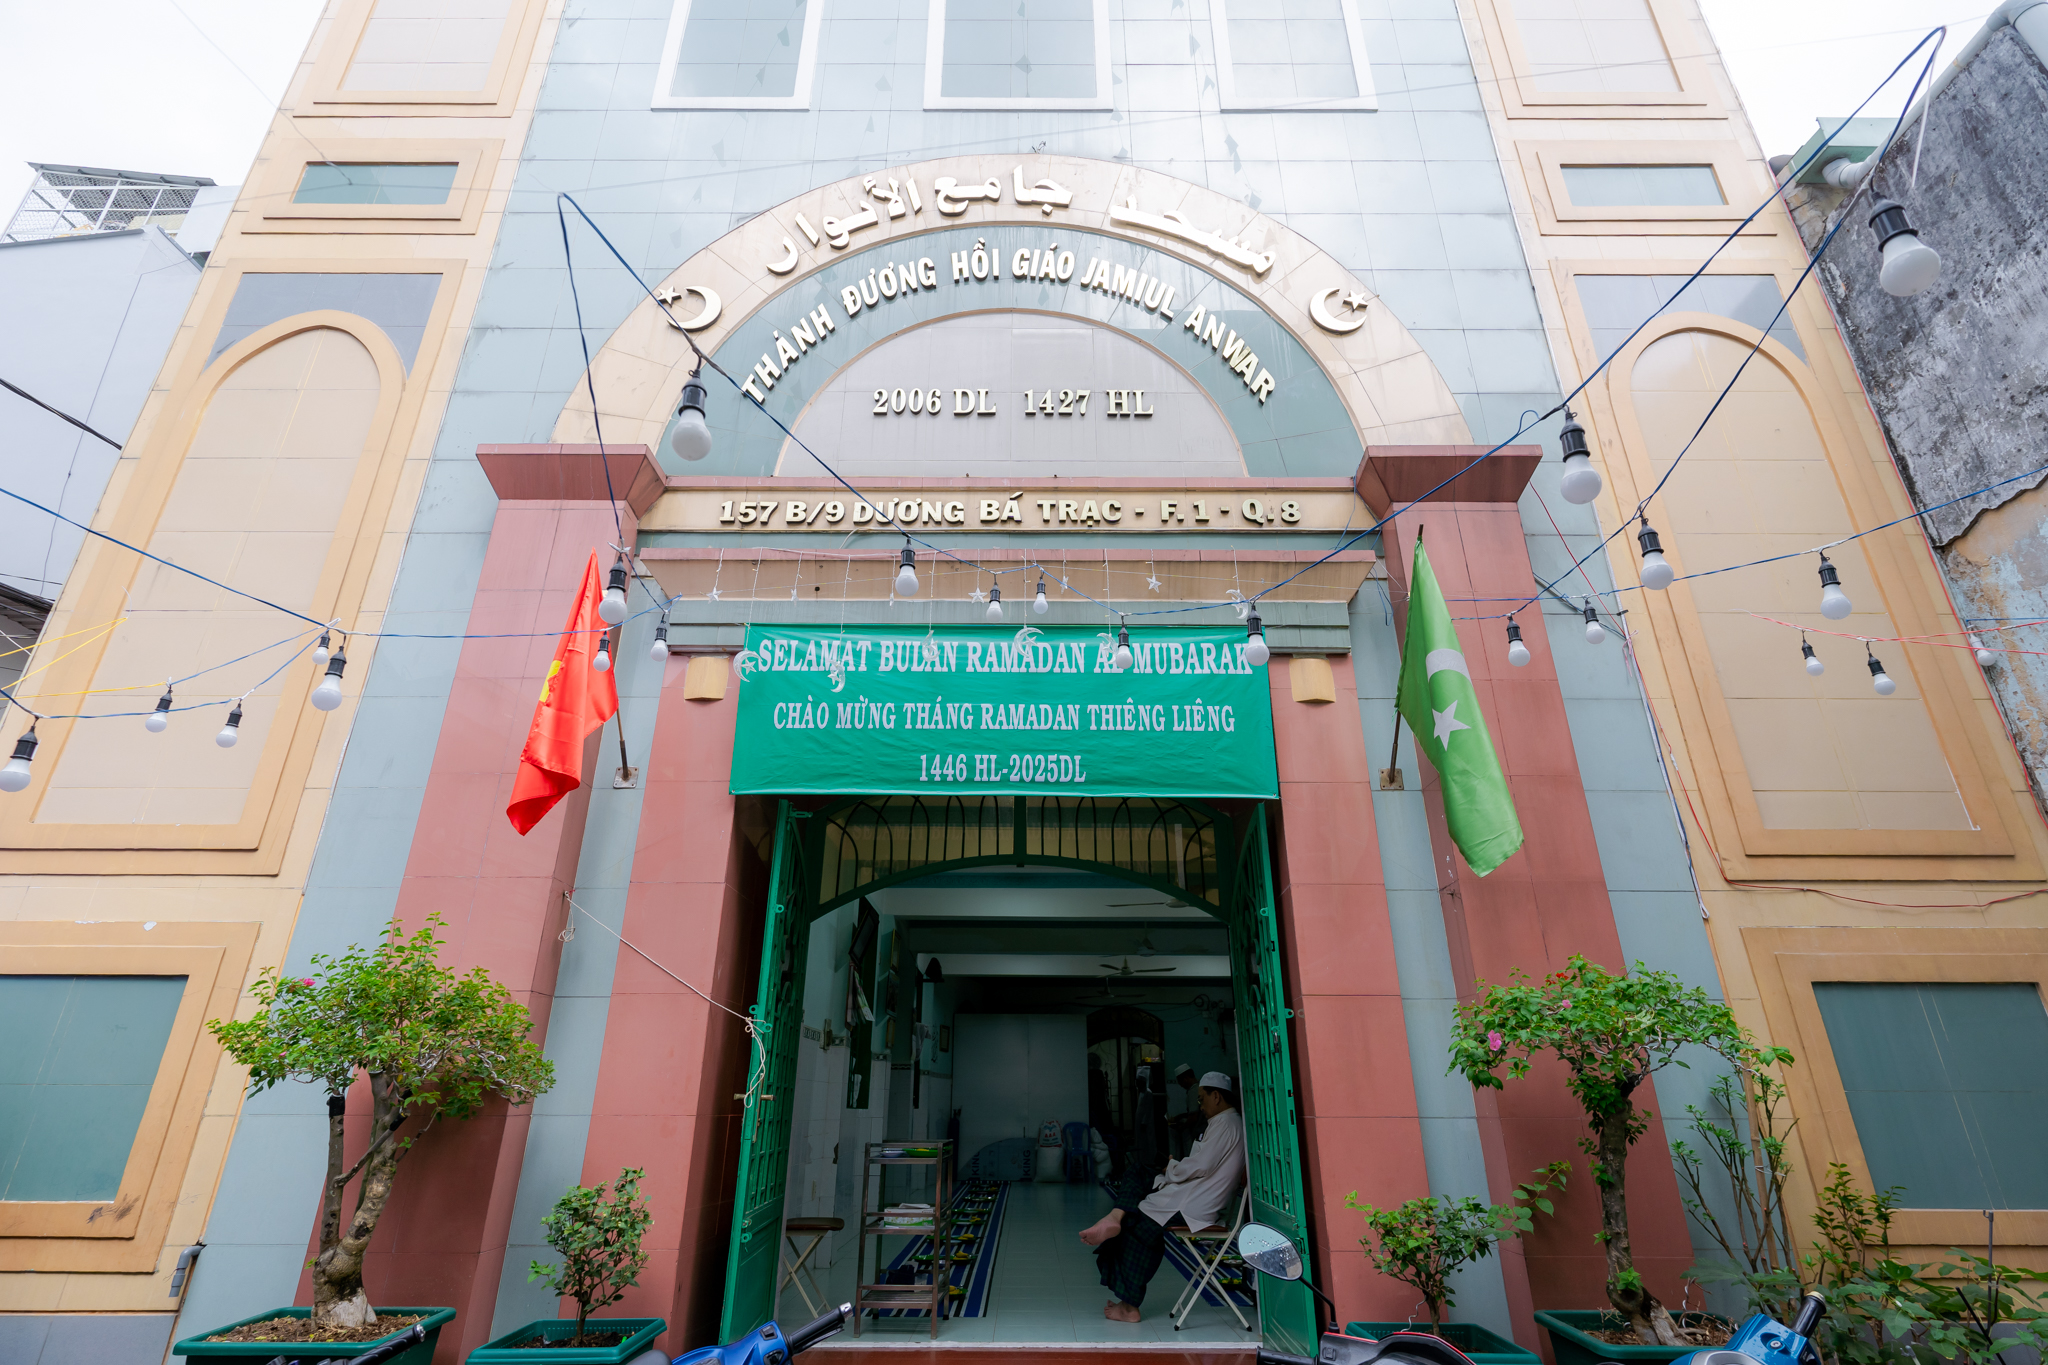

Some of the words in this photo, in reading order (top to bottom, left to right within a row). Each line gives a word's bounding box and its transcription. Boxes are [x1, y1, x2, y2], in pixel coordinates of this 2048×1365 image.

[935, 165, 1074, 216] جامع
[741, 303, 836, 405] THÁNH
[951, 237, 1000, 283] HỒI
[1011, 243, 1075, 283] GIÁO
[1080, 256, 1176, 321] JAMIUL
[1183, 304, 1276, 405] ANWAR
[872, 388, 942, 415] 2006
[953, 388, 997, 416] DL
[1024, 389, 1091, 416] 1427
[1106, 389, 1154, 418] HL
[719, 500, 778, 524] 157
[785, 501, 846, 525] B/9
[853, 497, 965, 525] DƯƠNG
[979, 491, 1024, 523] BÁ
[1037, 499, 1123, 527] TRẠC
[1242, 498, 1302, 526] Q.8
[758, 639, 872, 672] SELAMAT
[879, 640, 959, 673] BULAN
[966, 641, 1086, 673] RAMADAN
[1132, 642, 1253, 675] MUBARAK
[773, 695, 829, 729] CHÀO
[836, 695, 896, 729] MỪNG
[903, 695, 973, 730] THÁNG
[980, 703, 1080, 730] RAMADAN
[1087, 697, 1166, 731] THIÊNG
[1172, 698, 1235, 732] LIÊNG
[920, 754, 967, 782] 1446
[974, 754, 1086, 783] HL-2025DL
